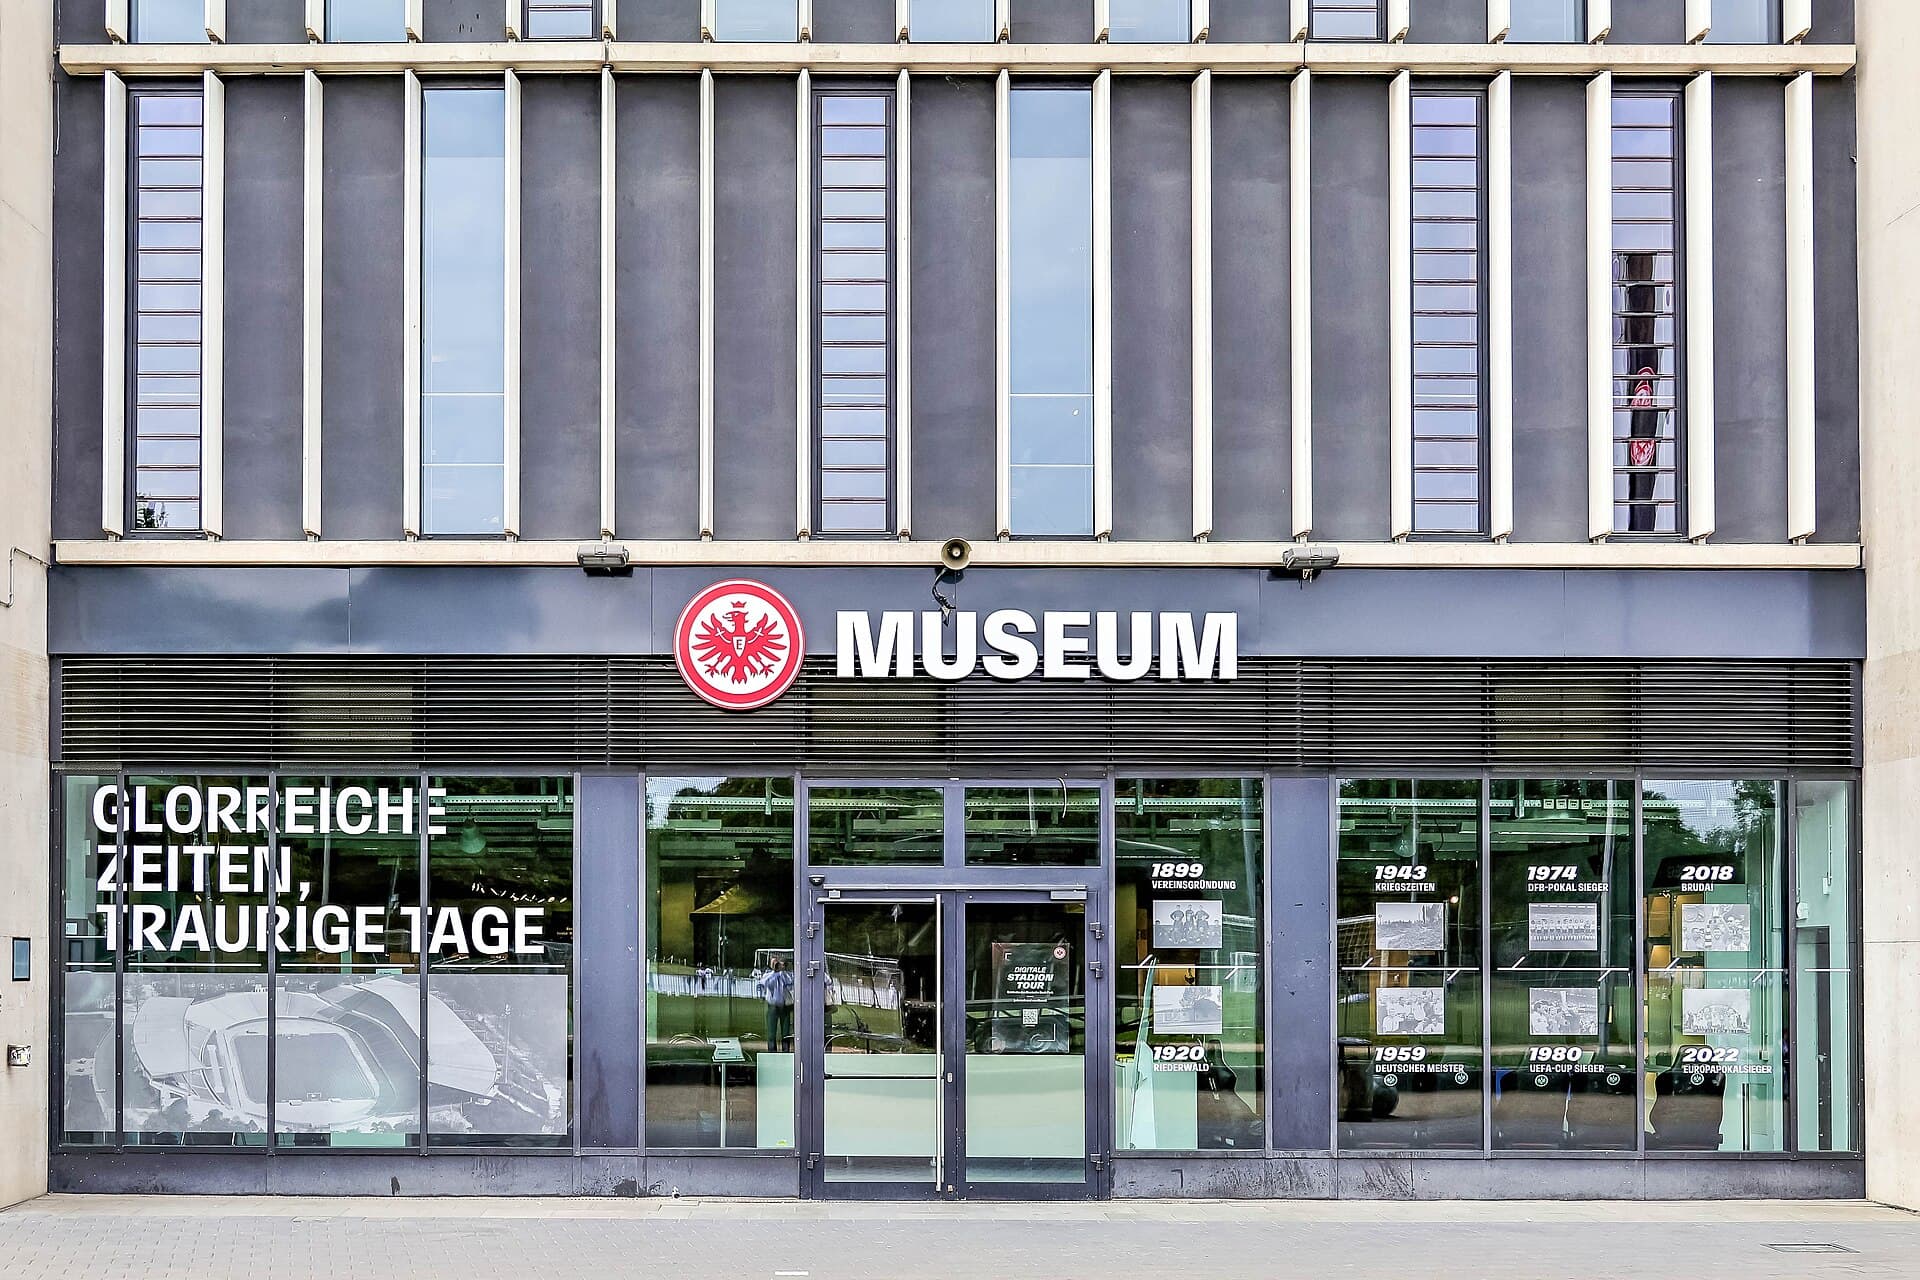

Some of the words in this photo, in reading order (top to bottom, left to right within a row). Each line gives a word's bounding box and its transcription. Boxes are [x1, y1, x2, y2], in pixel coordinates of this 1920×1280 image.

[836, 609, 1238, 681] MUSEUM
[92, 785, 447, 835] GLORREICHE
[96, 844, 311, 902] ZEITEN,
[1151, 863, 1204, 878] 1899
[1375, 865, 1427, 880] 1943
[1527, 865, 1578, 881] 1974
[1680, 865, 1734, 881] 2018
[1151, 879, 1237, 890] VEREINSGRÜNDUNG
[1375, 882, 1436, 892] KRIEGSZEITEN
[1527, 882, 1577, 892] DFB-POKAL
[1577, 882, 1609, 892] SIEGER
[1681, 882, 1714, 892] BRUDAI
[96, 904, 386, 952] TRAURIGE
[400, 905, 545, 954] TAGE
[1007, 973, 1054, 982] STADION
[1014, 966, 1047, 974] DIGITALE
[1017, 981, 1045, 990] TOUR
[1153, 1046, 1205, 1061] 1920
[1375, 1046, 1426, 1061] 1959
[1529, 1046, 1582, 1061] 1980
[1682, 1047, 1739, 1062] 2022
[1153, 1063, 1210, 1072] RIEDERWALD
[1375, 1063, 1426, 1073] DEUTSCHER
[1426, 1063, 1465, 1073] MEISTER
[1529, 1063, 1573, 1073] UEFA-CUP
[1574, 1063, 1605, 1073] SIEGER
[1683, 1065, 1772, 1074] EUROPAPOKALSIEGER
